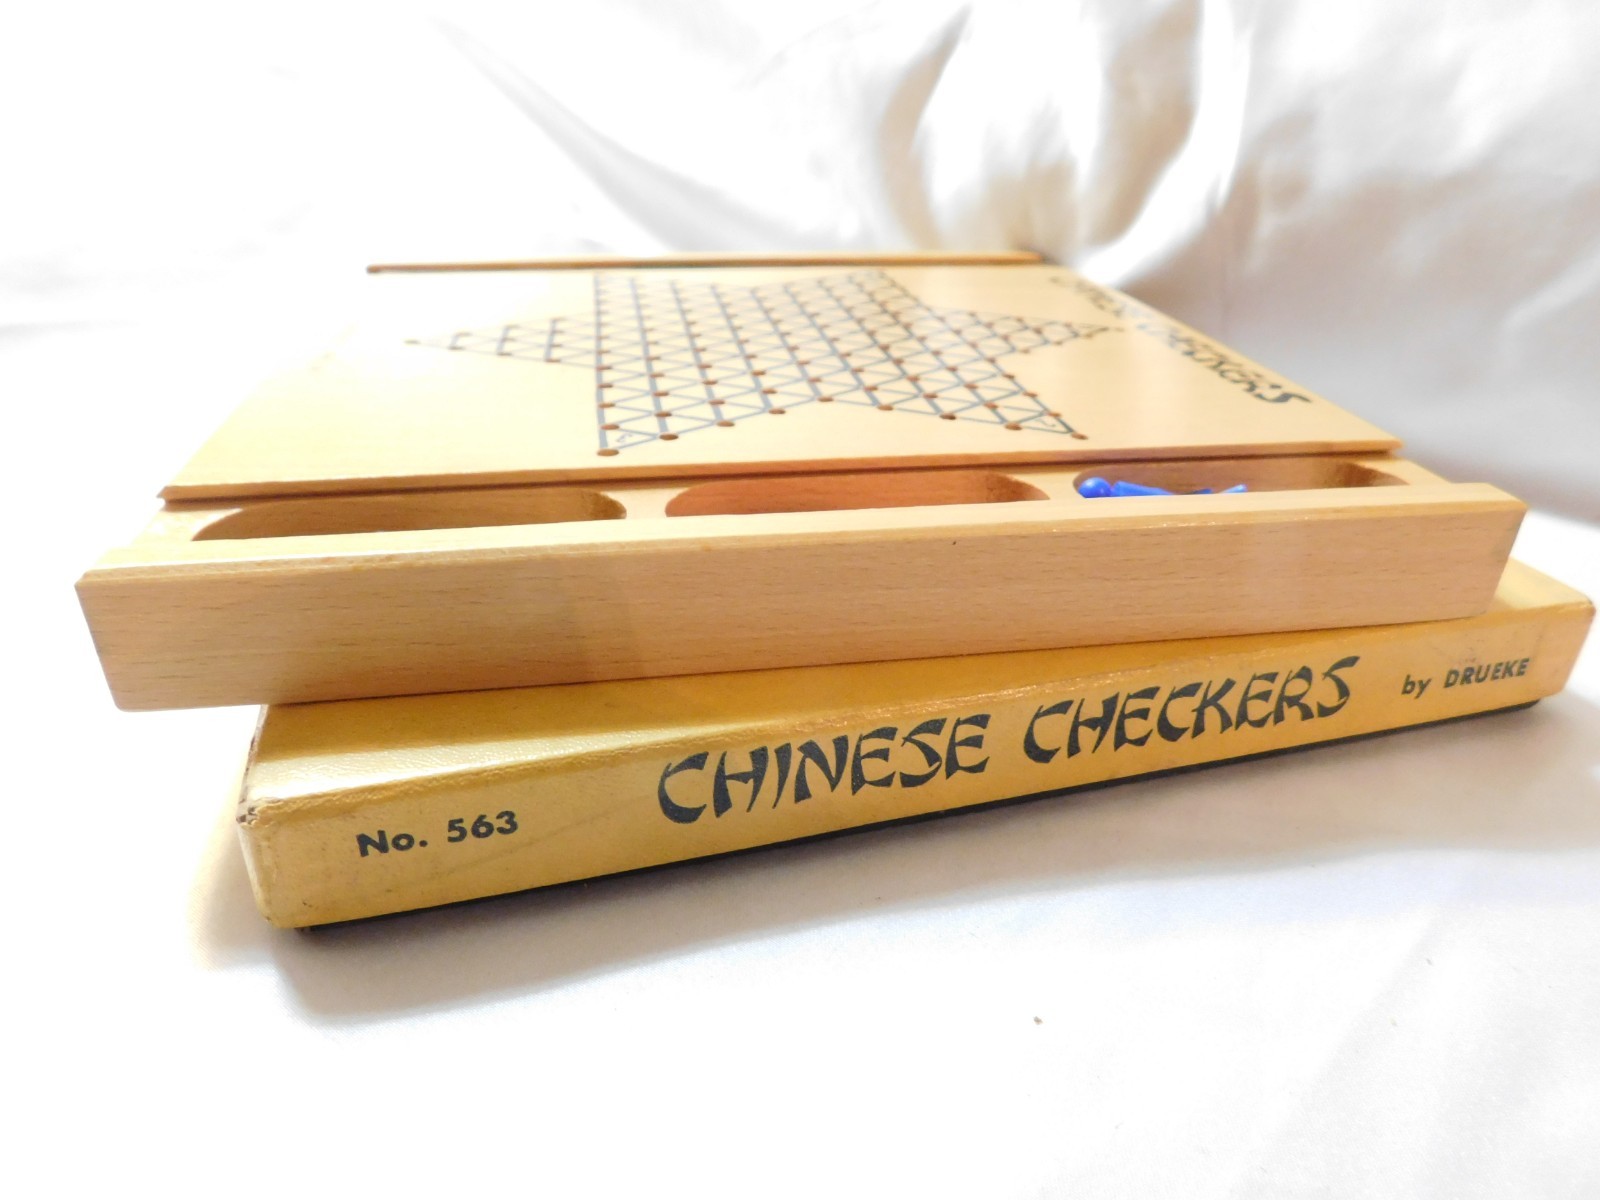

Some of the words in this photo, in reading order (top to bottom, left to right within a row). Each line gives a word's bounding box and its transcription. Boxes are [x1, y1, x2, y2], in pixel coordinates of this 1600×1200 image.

[1401, 674, 1432, 699] by
[1443, 658, 1531, 689] DRUEKE
[656, 713, 993, 826] CHINESE
[1022, 655, 1361, 765] CHECKERS
[355, 829, 429, 859] No.
[446, 810, 520, 844] 563
